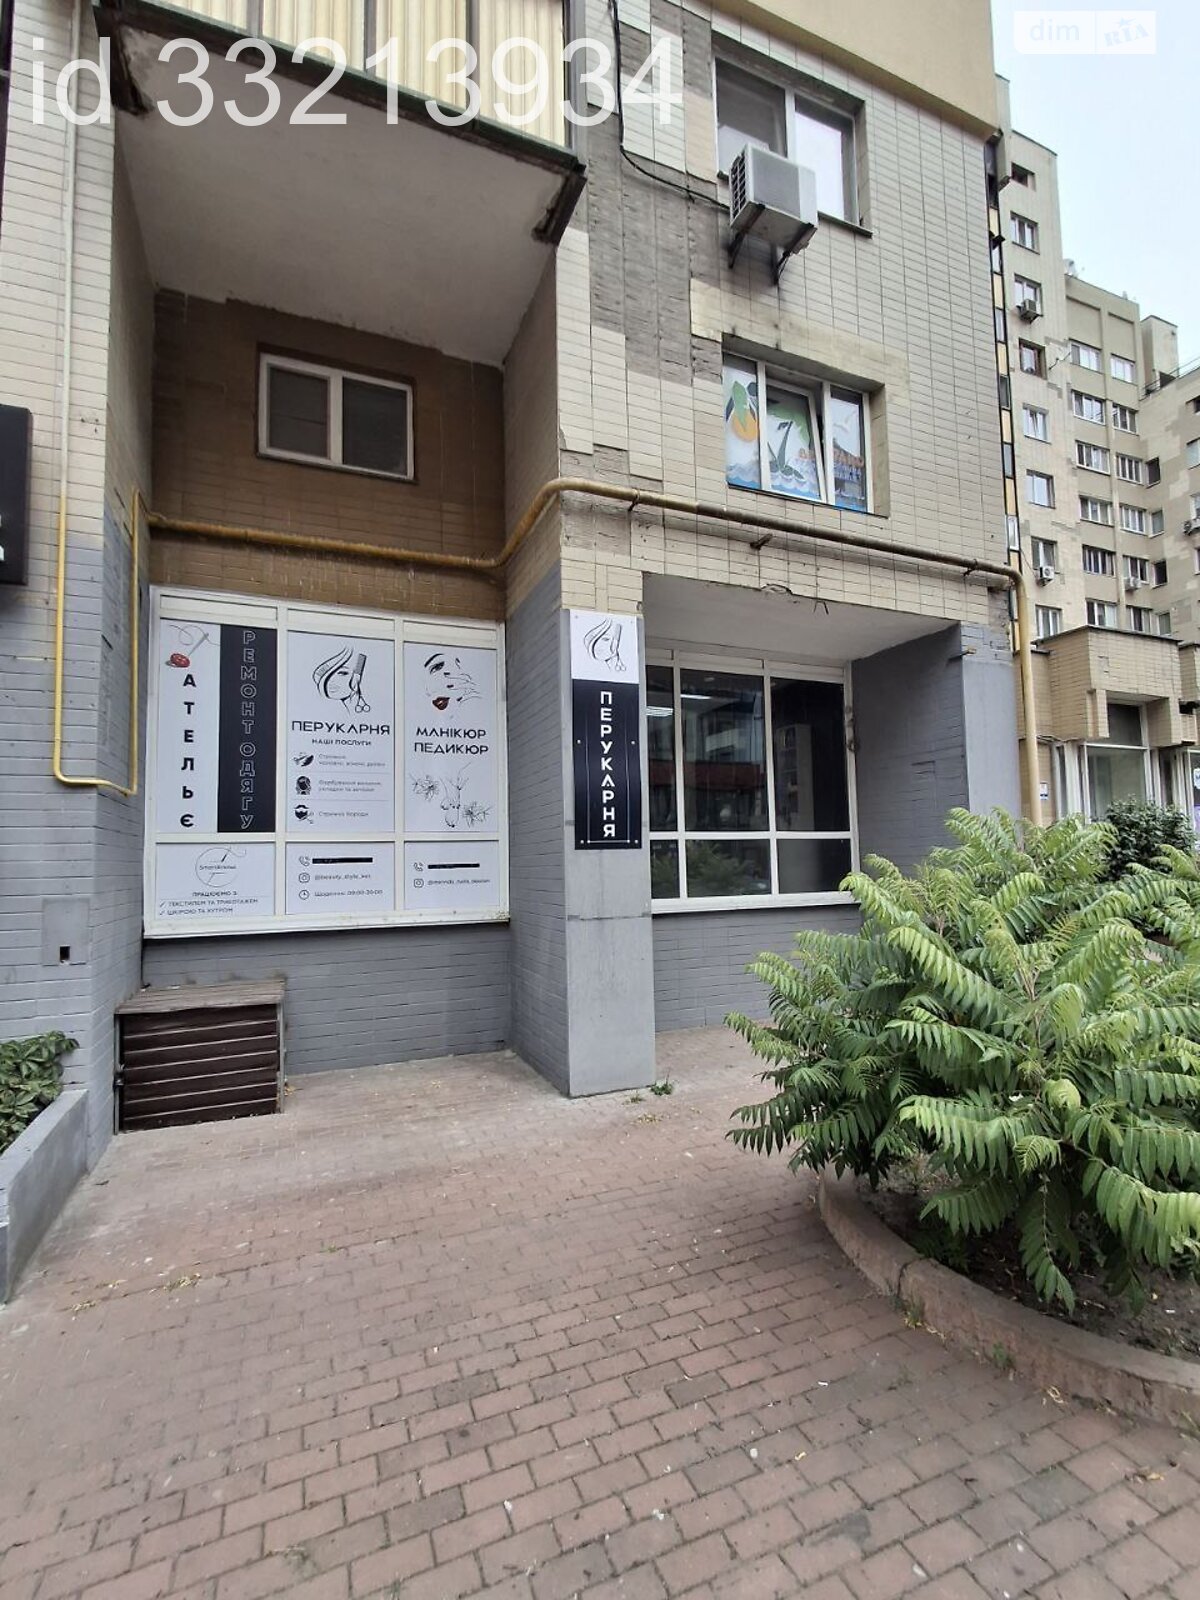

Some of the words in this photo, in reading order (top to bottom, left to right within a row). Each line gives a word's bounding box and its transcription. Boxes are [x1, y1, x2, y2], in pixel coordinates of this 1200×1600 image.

[240, 630, 257, 735] РЕМОНТ
[180, 673, 197, 828] АТЕЛЬЄ
[291, 720, 390, 735] ПЕРУКАРНЯ
[414, 742, 489, 755] ПЕДИКЮР
[416, 726, 487, 739] МАНІКЮР
[600, 690, 616, 838] ПЕРУКАРНЯ
[239, 741, 256, 830] ОДЯГУ
